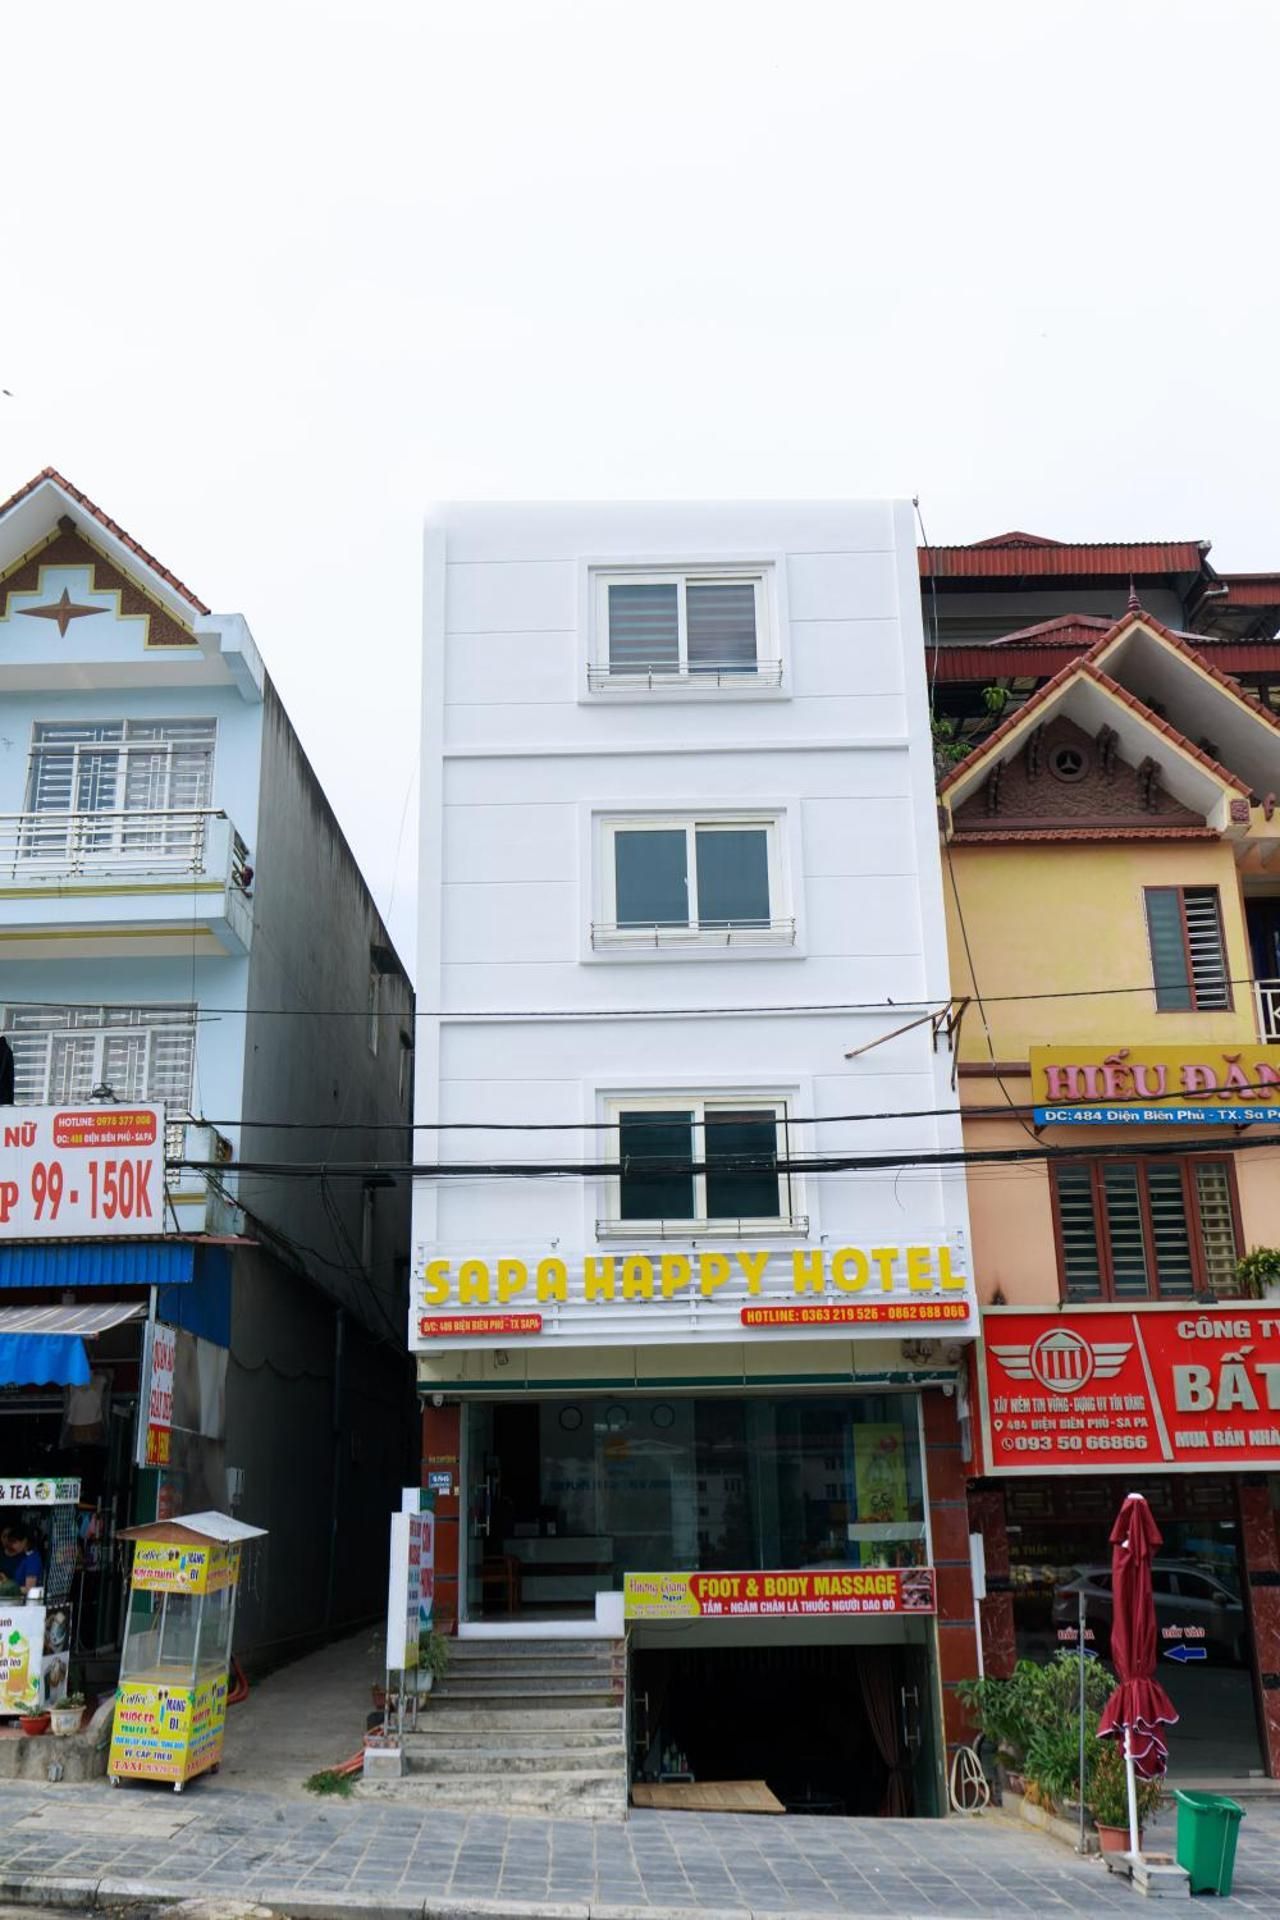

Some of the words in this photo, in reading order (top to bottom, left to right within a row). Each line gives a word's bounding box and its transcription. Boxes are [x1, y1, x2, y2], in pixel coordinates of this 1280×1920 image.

[1045, 1048, 1167, 1100] HIẾU
[58, 1117, 95, 1127] HOTLINE:
[1106, 1110, 1139, 1123] Điện
[1143, 1110, 1174, 1121] Biên
[1177, 1108, 1205, 1120] Phủ
[1218, 1110, 1242, 1120] TX.
[1244, 1110, 1263, 1119] Sa
[4, 1121, 37, 1147] NỮ
[31, 1161, 63, 1220] 99
[70, 1190, 78, 1203] -
[88, 1159, 153, 1220] 150K
[424, 1257, 567, 1304] SAPA
[584, 1250, 770, 1301] HAPPY
[793, 1246, 966, 1294] HOTEL
[512, 1319, 520, 1329] TX
[747, 1311, 800, 1323] HOTLINE:
[802, 1309, 830, 1322] 0363
[833, 1308, 854, 1321] 219
[1177, 1316, 1251, 1339] CÔNG
[1172, 1345, 1280, 1412] BẤT
[1007, 1420, 1027, 1430] 484
[1031, 1416, 1056, 1432] ĐIỆN
[1059, 1416, 1084, 1429] BIÊN
[1087, 1415, 1109, 1428] PHỦ
[1116, 1418, 1131, 1428] SA
[1134, 1417, 1148, 1427] PA
[1015, 1436, 1051, 1450] 093
[1057, 1436, 1082, 1449] 50
[1175, 1431, 1210, 1447] MUA
[1212, 1426, 1245, 1446] BÁN
[10, 1485, 31, 1499] TEA
[699, 1578, 740, 1598] FOOT
[746, 1578, 759, 1597] &
[764, 1577, 808, 1597] BODY
[814, 1575, 897, 1596] MASSAGE
[760, 1599, 785, 1612] CHÂN
[787, 1598, 799, 1612] LÁ
[801, 1597, 830, 1612] THUỐC
[832, 1597, 859, 1611] NGƯỜI
[863, 1599, 880, 1611] DAO
[882, 1596, 895, 1610] ĐỎ
[114, 1761, 142, 1771] TAXI
